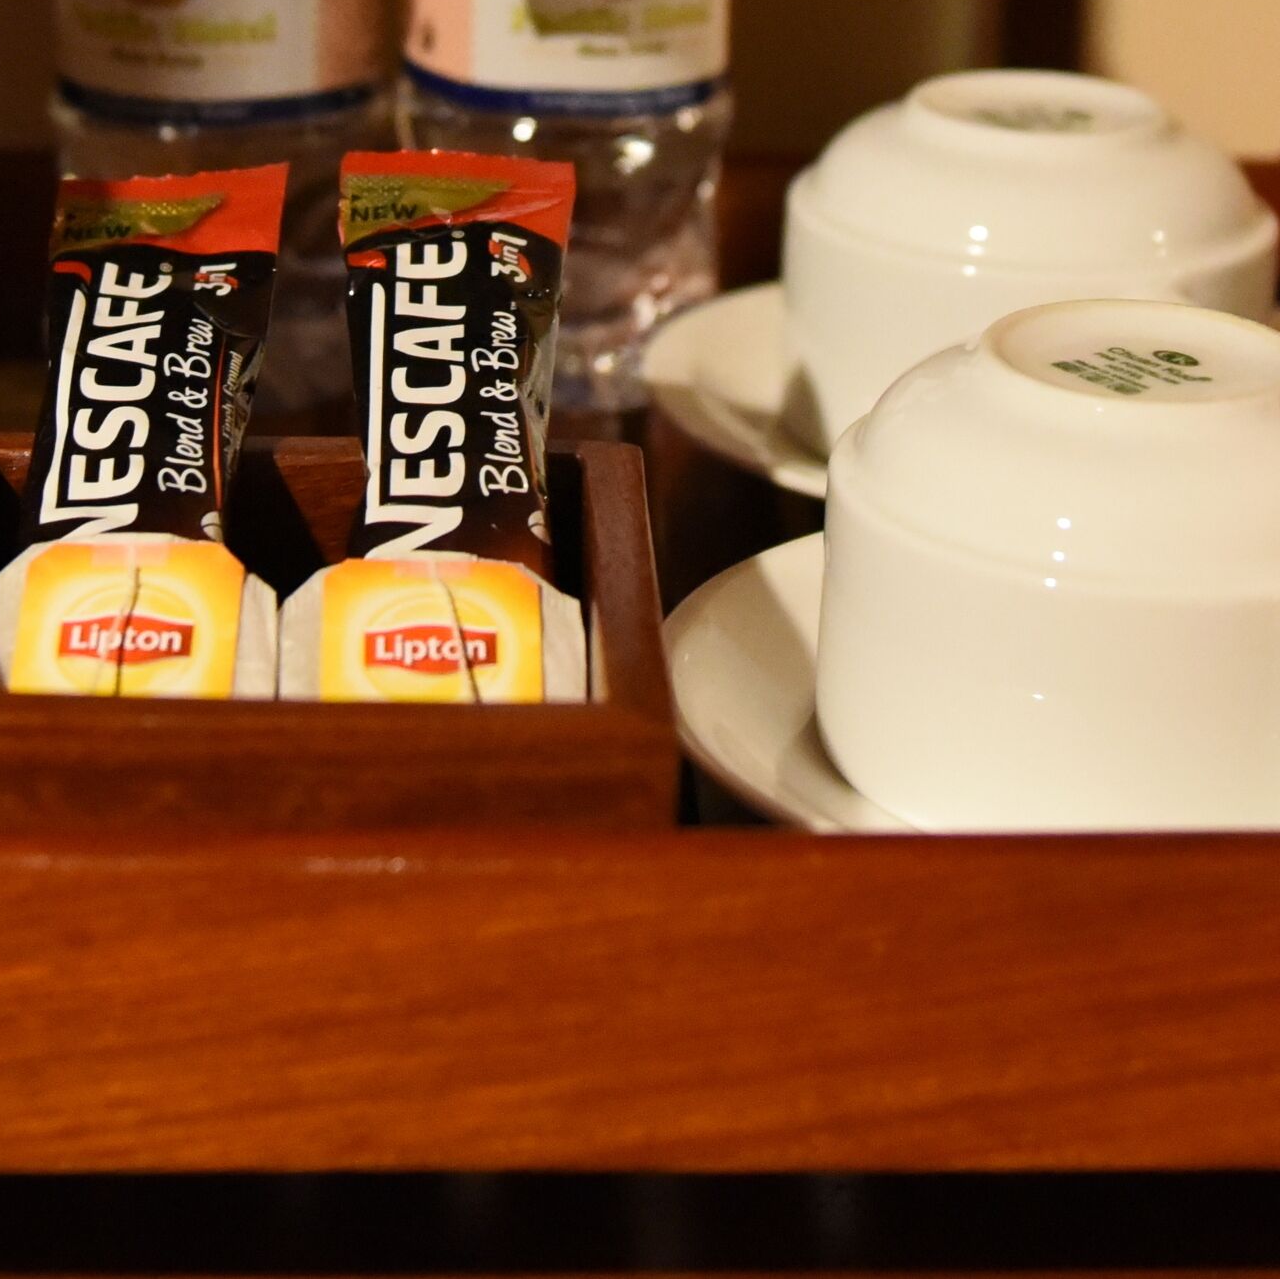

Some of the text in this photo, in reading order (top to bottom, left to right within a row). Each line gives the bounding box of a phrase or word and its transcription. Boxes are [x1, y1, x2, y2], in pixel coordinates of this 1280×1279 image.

[350, 203, 418, 222] NEW
[499, 231, 529, 283] 3in1
[157, 318, 214, 494] Blend & Brew
[471, 310, 529, 497] Blend & Brew
[70, 622, 183, 662] Lipton
[374, 633, 487, 666] Lipton
